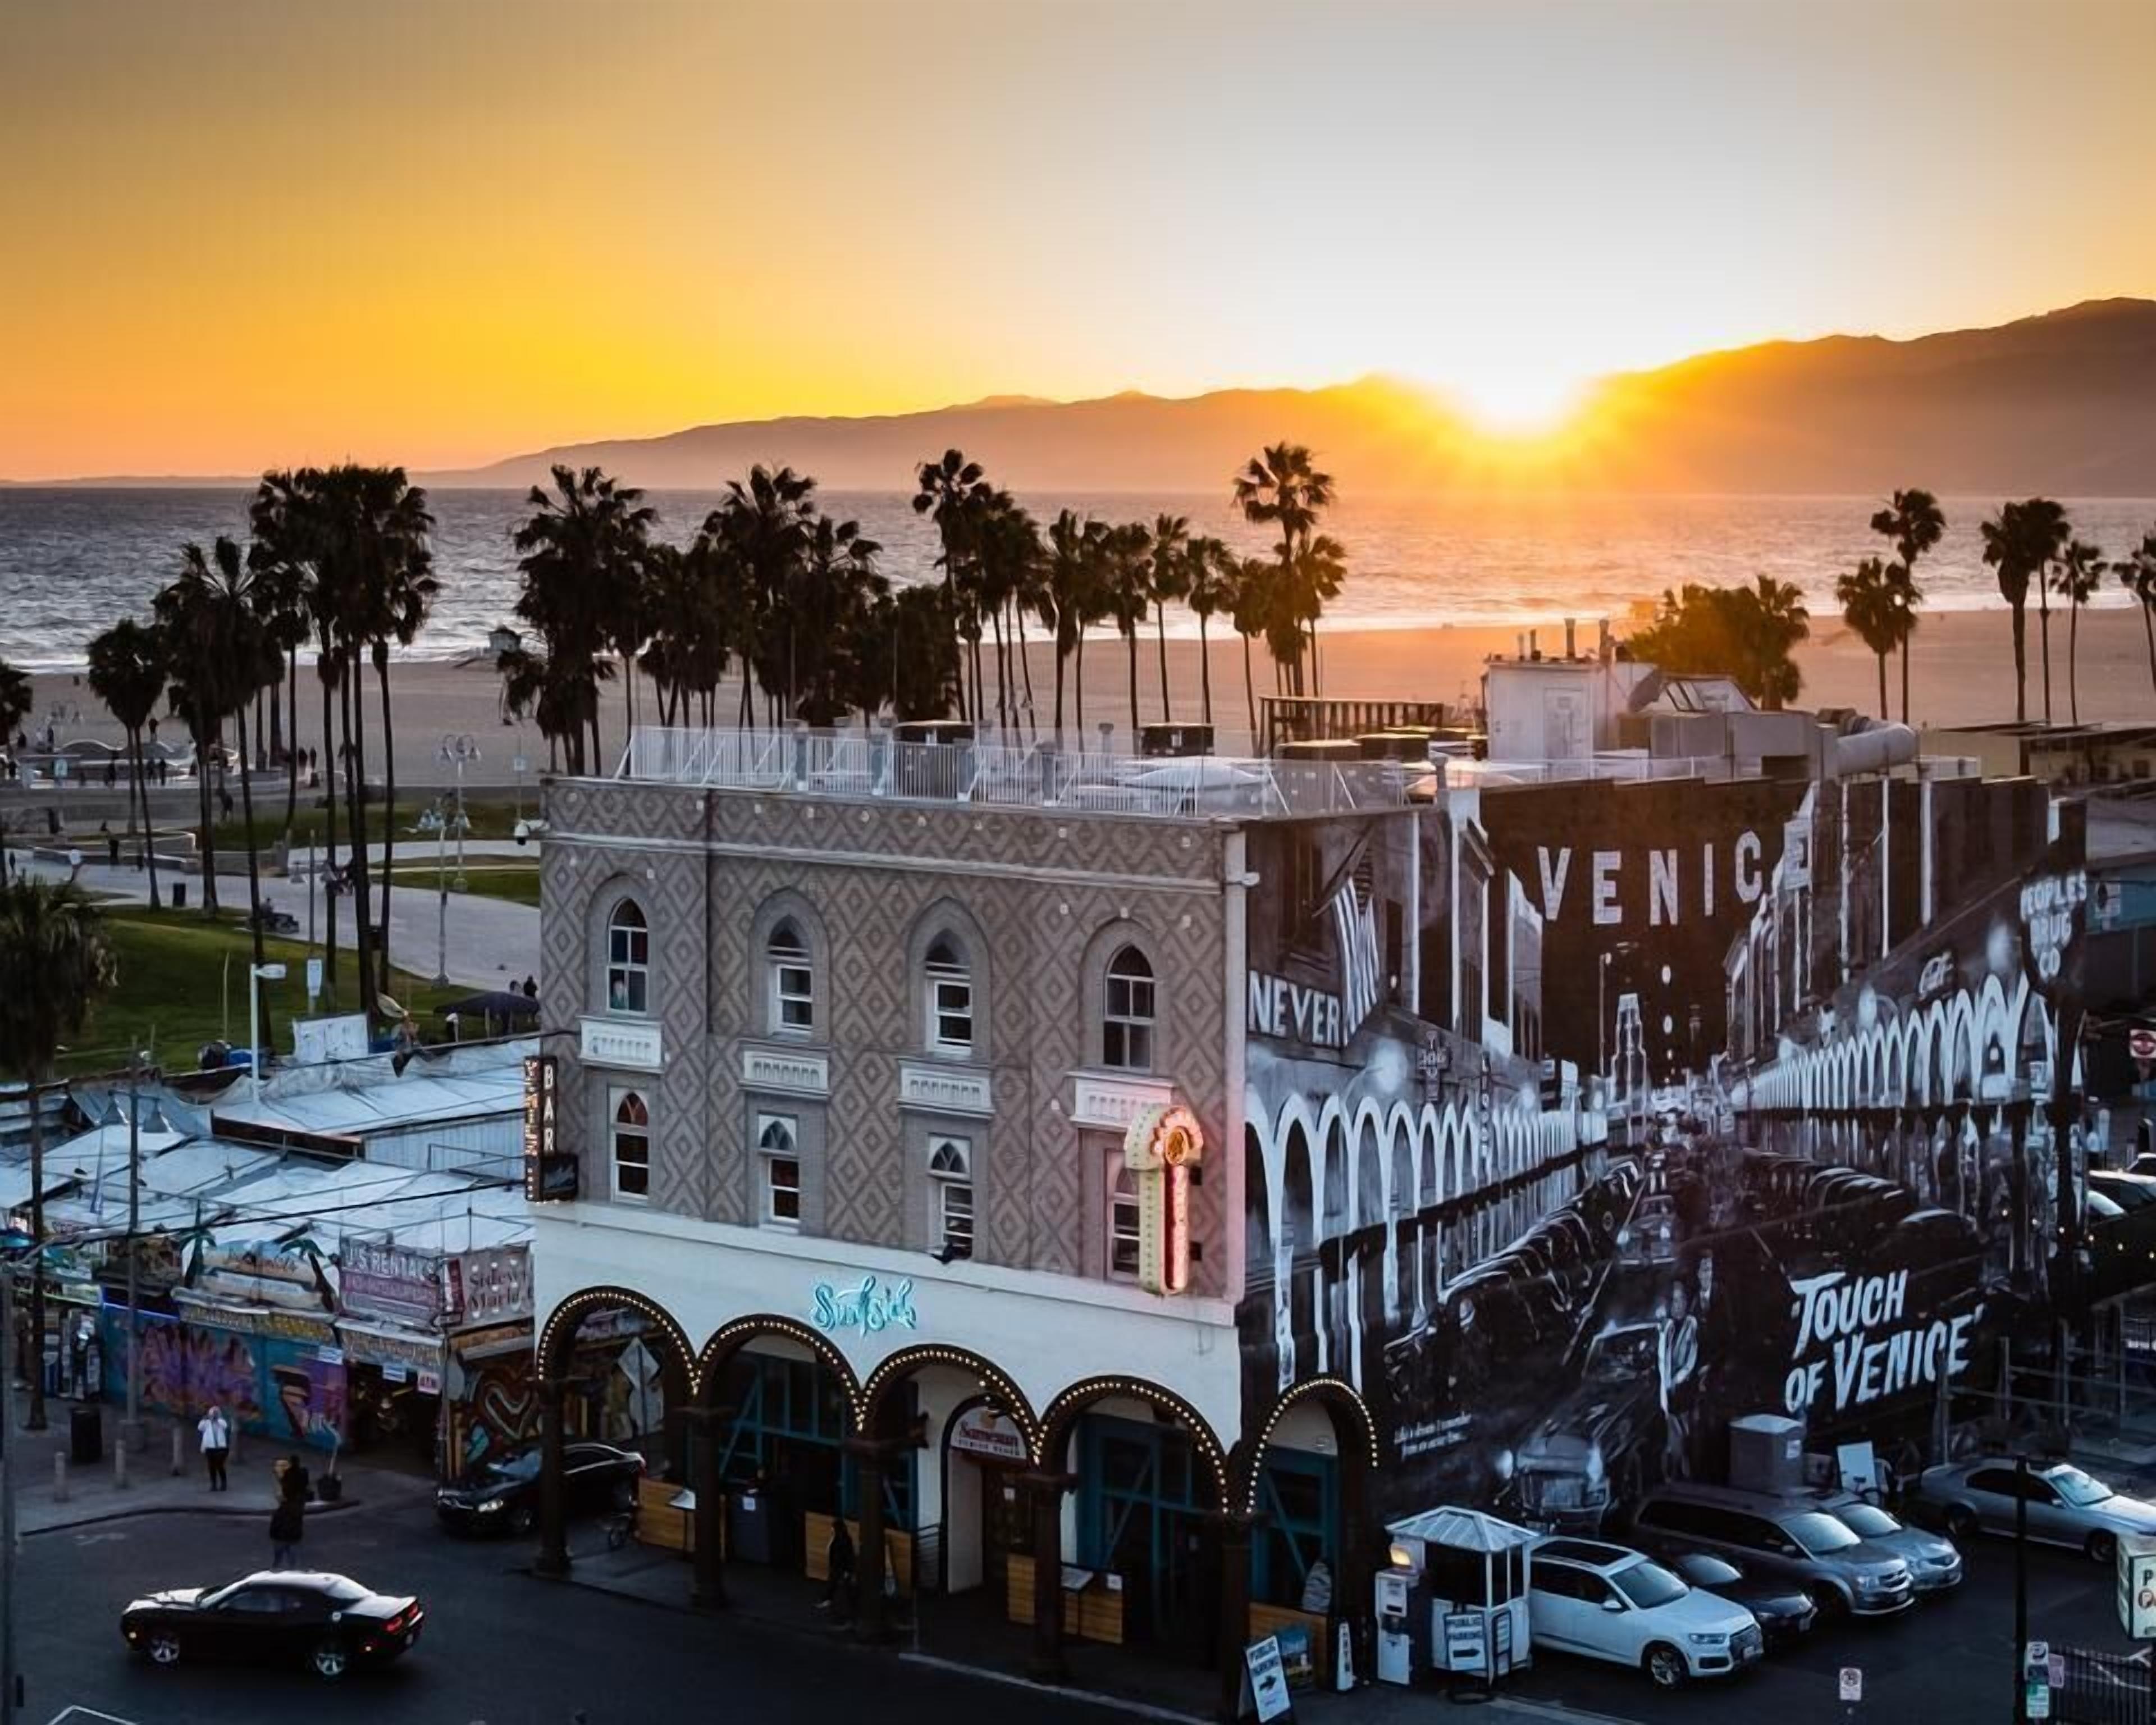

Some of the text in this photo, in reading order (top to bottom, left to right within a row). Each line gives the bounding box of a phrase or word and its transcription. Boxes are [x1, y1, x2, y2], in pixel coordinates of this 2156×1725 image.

[1537, 817, 1812, 926] VENICE
[1248, 970, 1341, 1047] NEVER
[543, 1064, 555, 1151] BAR
[1789, 1269, 1908, 1359] TOUCH
[1833, 1303, 1986, 1411] VENICE
